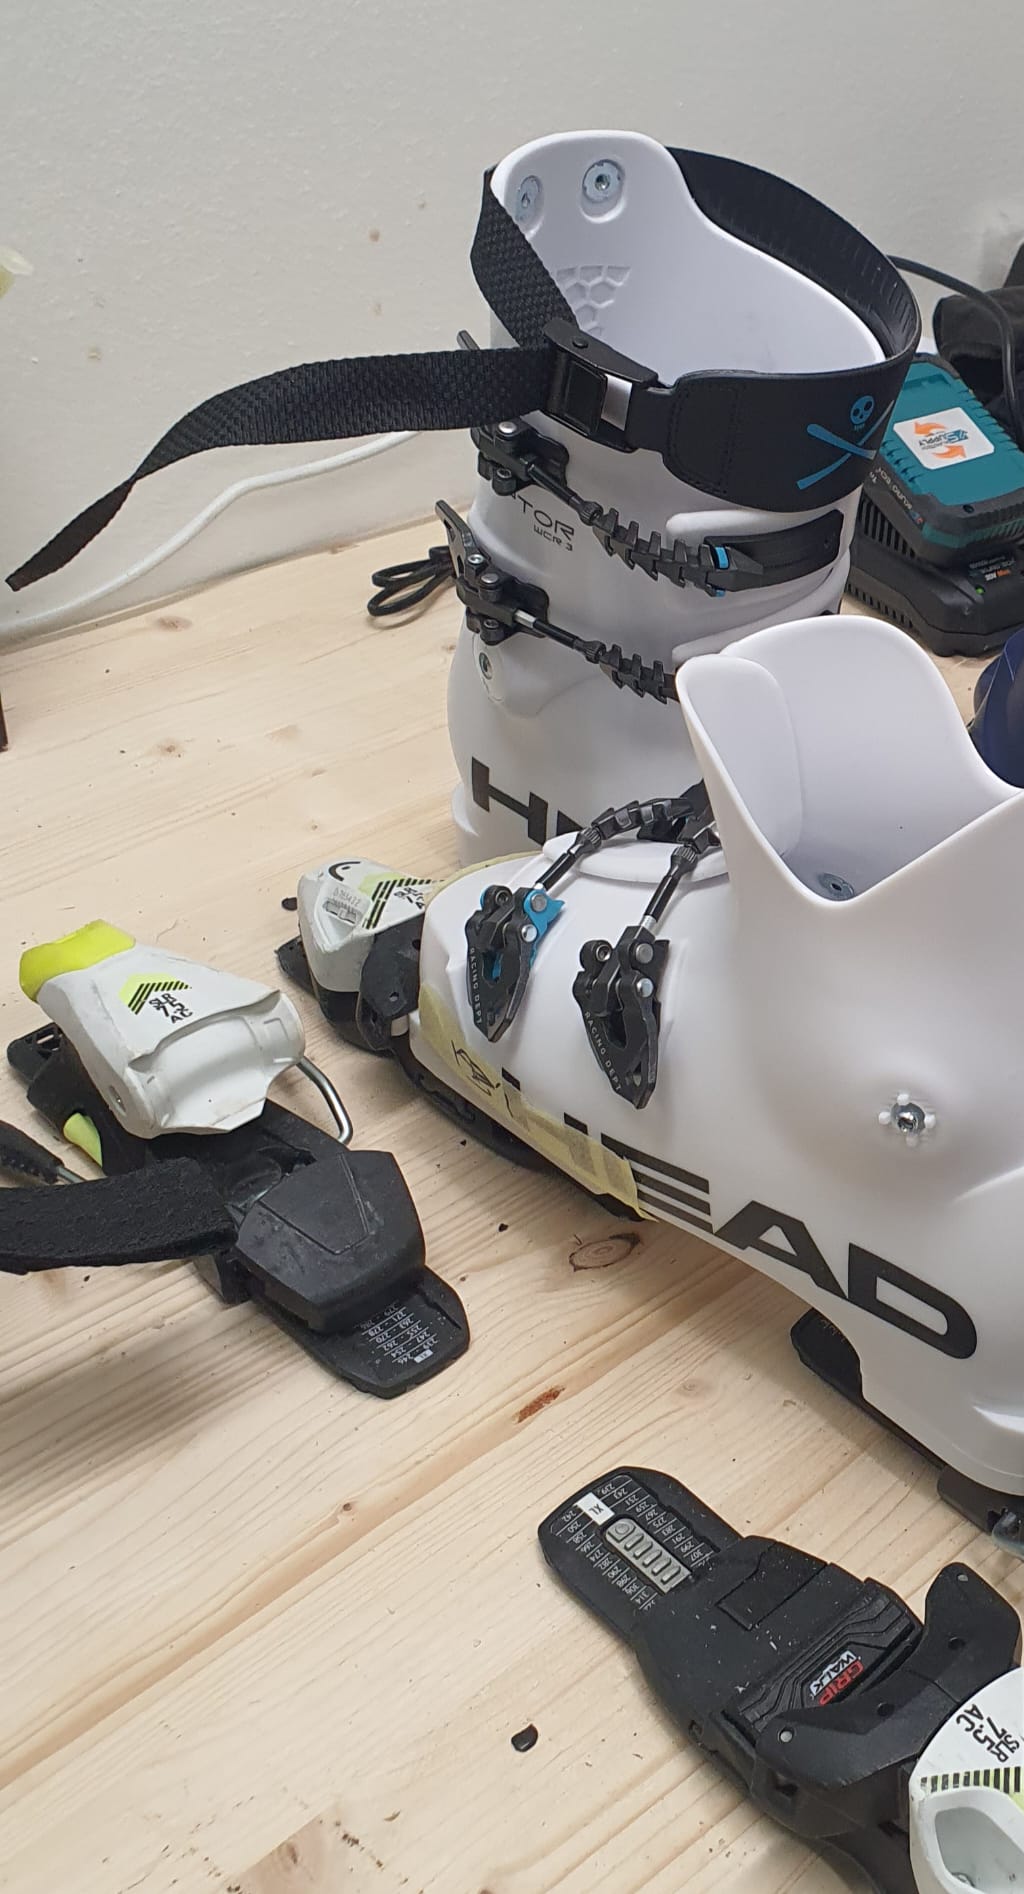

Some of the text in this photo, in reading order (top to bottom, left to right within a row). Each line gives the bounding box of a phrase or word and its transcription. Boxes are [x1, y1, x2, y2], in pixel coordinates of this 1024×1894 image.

[468, 947, 484, 1025] RACING DEPT
[584, 1011, 623, 1092] RACING DEPT
[614, 1489, 628, 1501] 243
[625, 1495, 640, 1507] 251
[588, 1503, 605, 1516] XL
[636, 1501, 650, 1513] 259
[645, 1508, 659, 1521] 267
[652, 1516, 668, 1529] 275
[662, 1524, 677, 1536] 283
[671, 1533, 686, 1546] 291
[680, 1541, 695, 1554] 299
[689, 1550, 704, 1563] 307
[809, 1649, 858, 1697] WALK
[818, 1660, 865, 1707] GRIP
[955, 1702, 985, 1733] AC
[971, 1715, 1009, 1752] 7.5
[989, 1733, 1021, 1764] SLR
